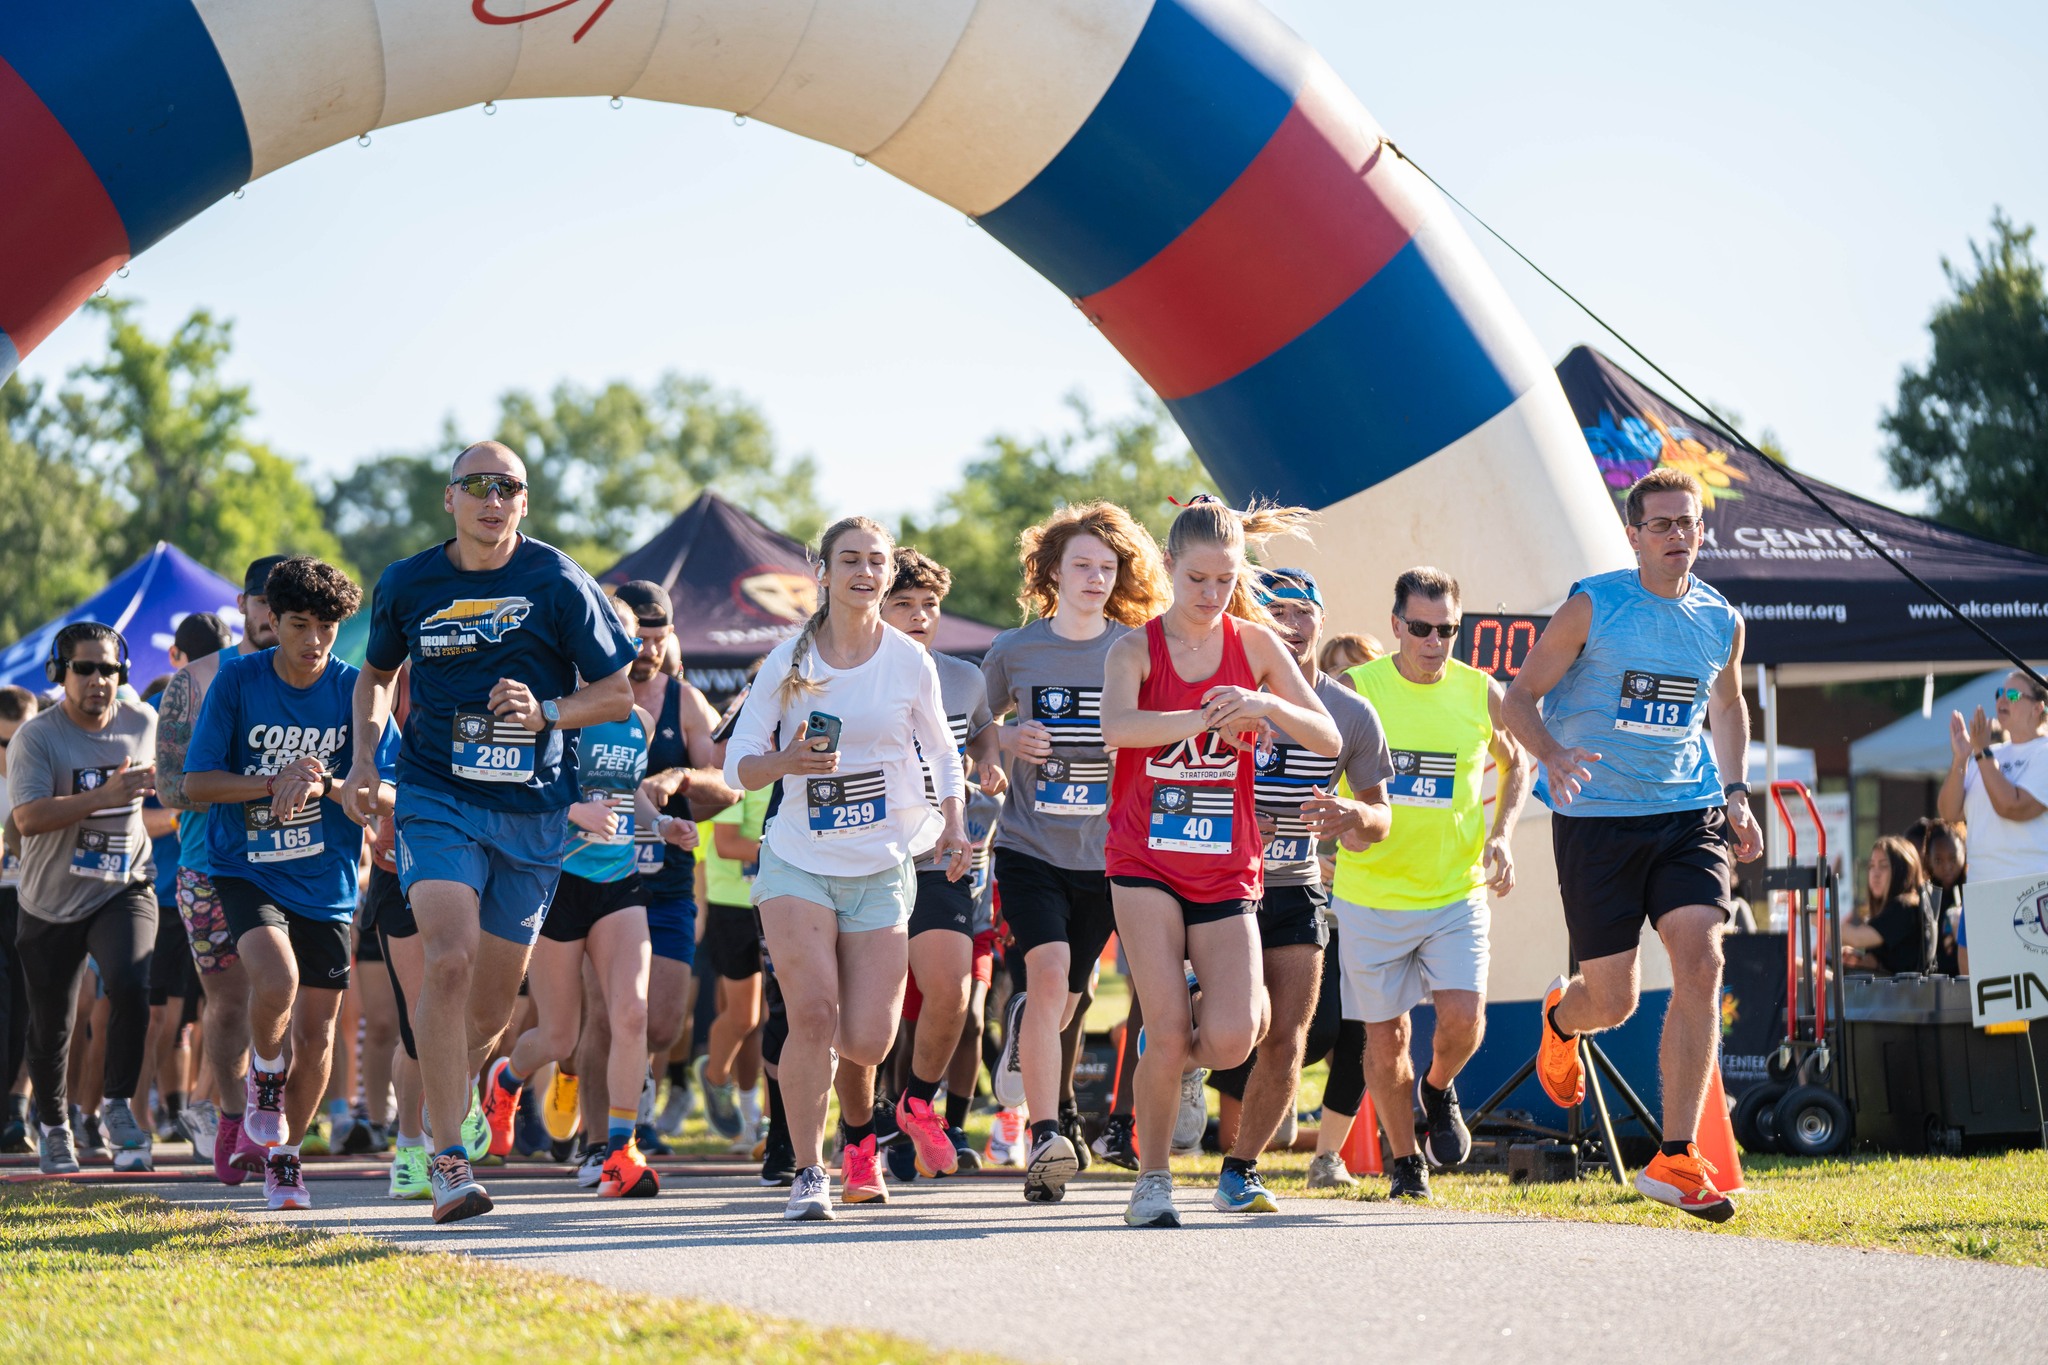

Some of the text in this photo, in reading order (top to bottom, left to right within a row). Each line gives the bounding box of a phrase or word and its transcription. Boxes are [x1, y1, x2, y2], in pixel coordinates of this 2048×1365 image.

[1734, 527, 1888, 548] CENTER
[1735, 601, 1847, 623] kcenter.org
[1908, 600, 2048, 620] wwwekcenter.
[420, 630, 477, 647] IRONMAN
[421, 646, 440, 657] 70.3
[441, 647, 478, 656] CAROLINA
[1644, 702, 1680, 725] 113
[248, 724, 348, 753] COBRAS
[475, 745, 521, 769] 280
[591, 743, 637, 760] FLEET
[595, 756, 635, 772] FEET
[587, 770, 633, 779] RACING TEAM
[1180, 771, 1218, 779] STRATFORD
[1062, 784, 1089, 804] 42
[1411, 777, 1437, 797] 45
[617, 814, 629, 835] 2
[832, 802, 875, 828] 259
[270, 826, 311, 850] 165
[1182, 817, 1214, 840] 40
[1263, 839, 1298, 860] 264
[97, 853, 122, 872] 39
